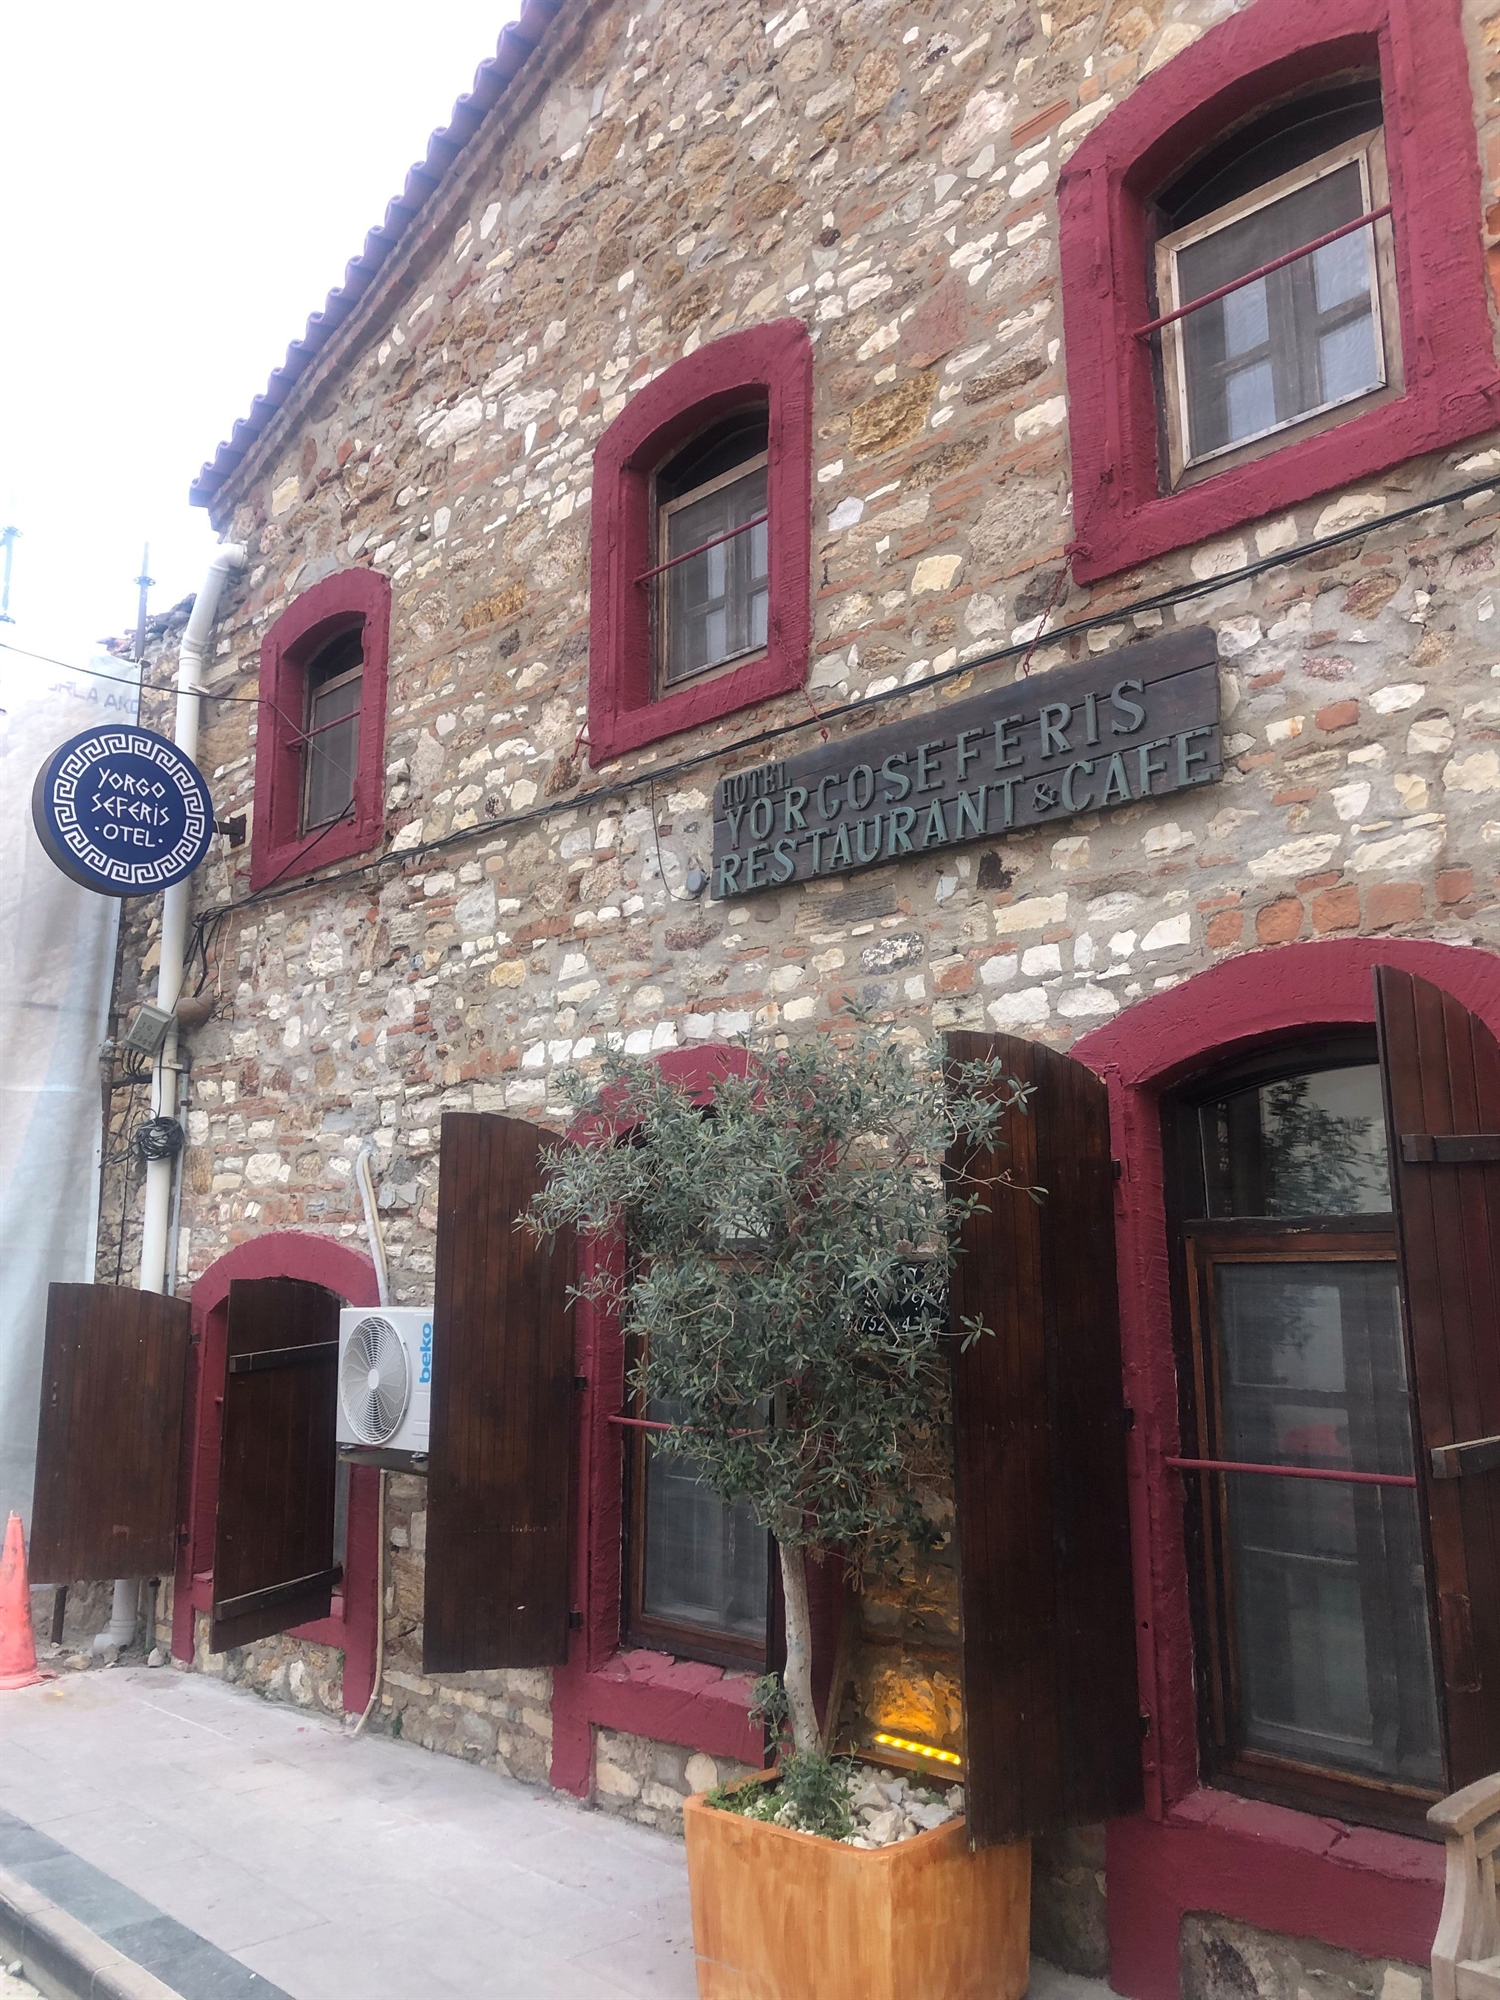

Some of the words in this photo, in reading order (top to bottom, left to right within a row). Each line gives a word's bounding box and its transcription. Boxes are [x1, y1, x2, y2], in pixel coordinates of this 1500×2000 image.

[97, 767, 166, 798] YORGO
[721, 761, 792, 808] HOTEL
[103, 823, 156, 847] OTEL
[718, 775, 1025, 897] RESTAURANT
[1061, 726, 1212, 813] CAFE
[419, 1322, 431, 1383] beko
